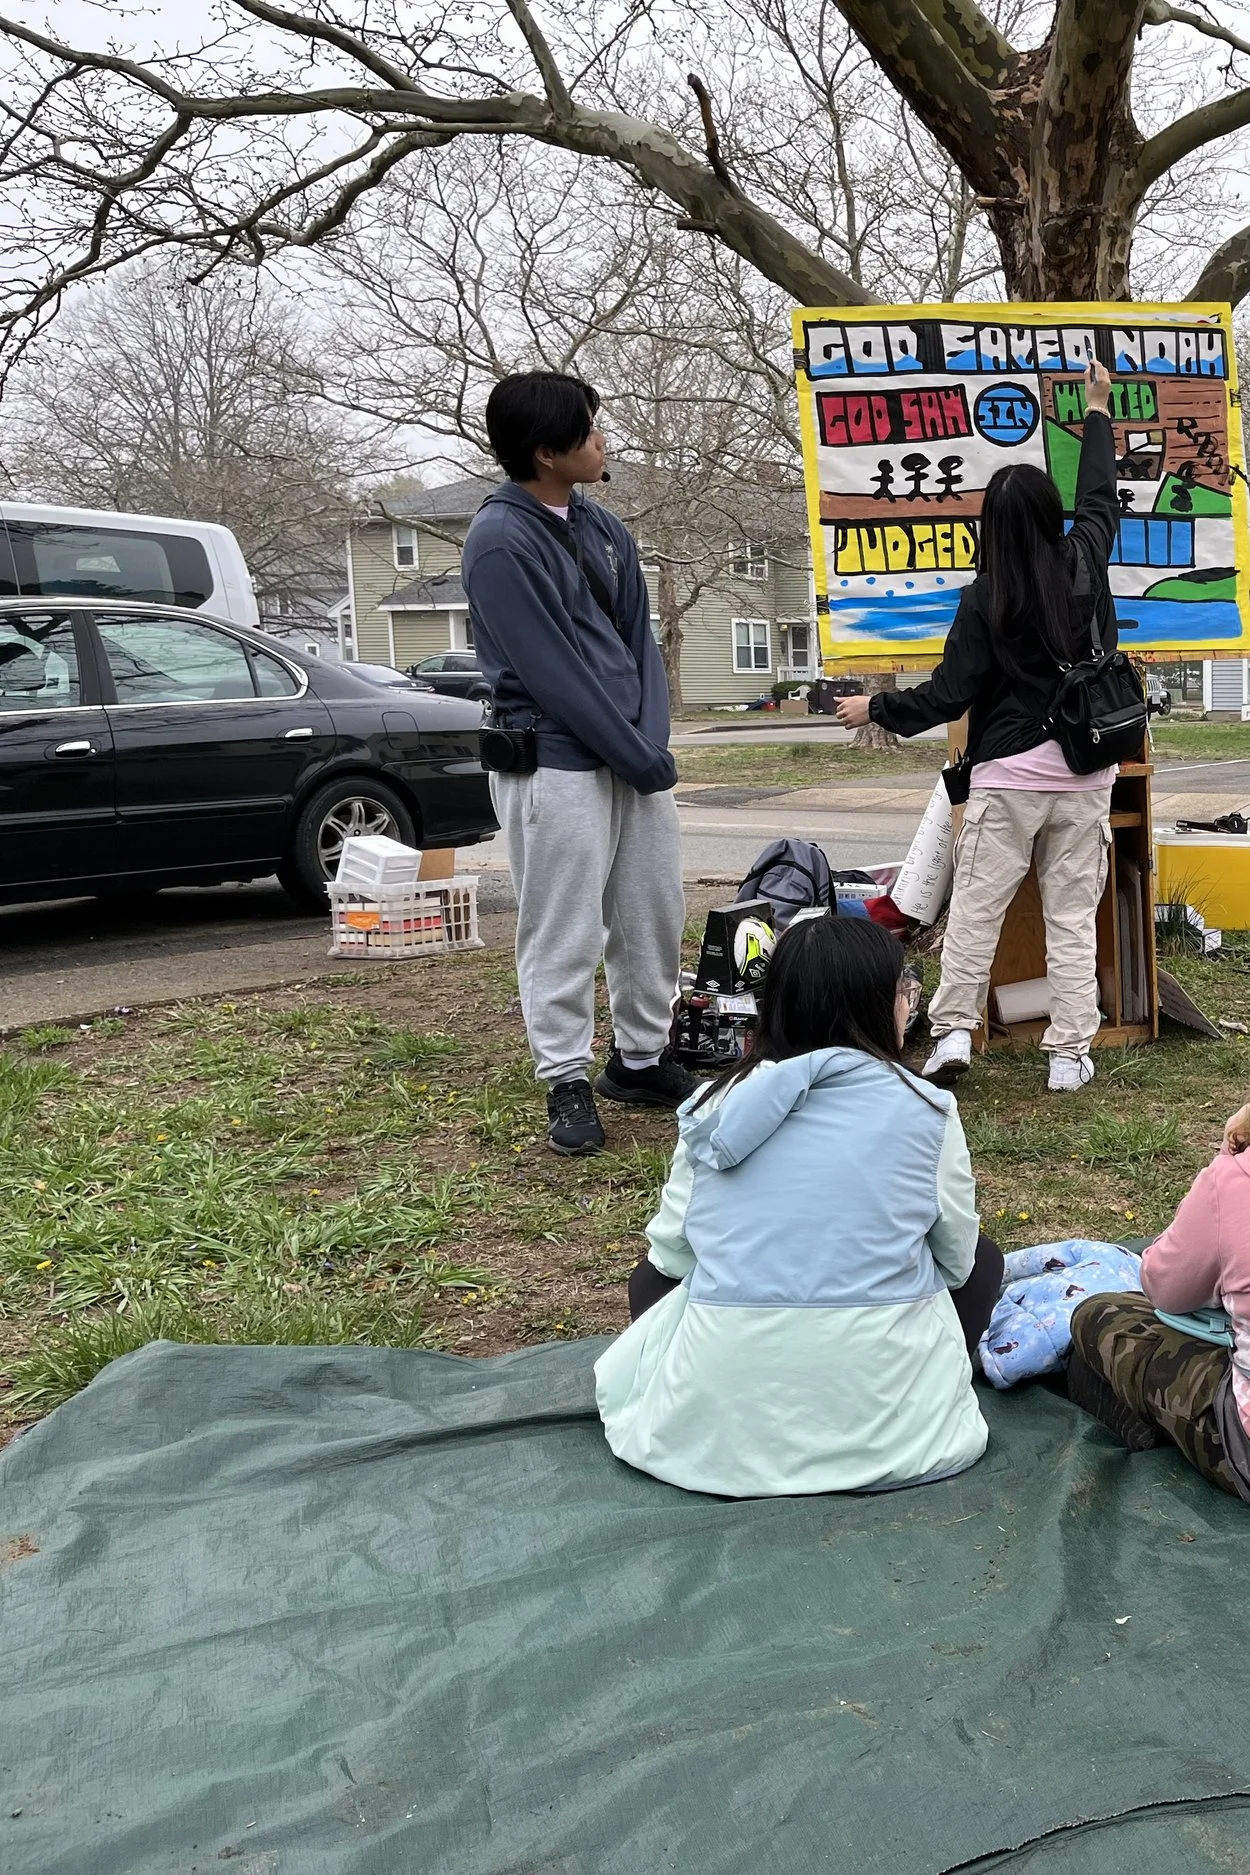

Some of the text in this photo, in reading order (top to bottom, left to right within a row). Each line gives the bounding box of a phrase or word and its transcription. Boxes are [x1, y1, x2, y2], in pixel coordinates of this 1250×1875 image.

[807, 325, 924, 377] GOD
[1112, 330, 1224, 377] NOAH
[821, 389, 969, 444] GOD SAW
[978, 400, 1034, 427] SIN
[1054, 383, 1156, 421] WTED
[835, 522, 976, 573] JUDGED
